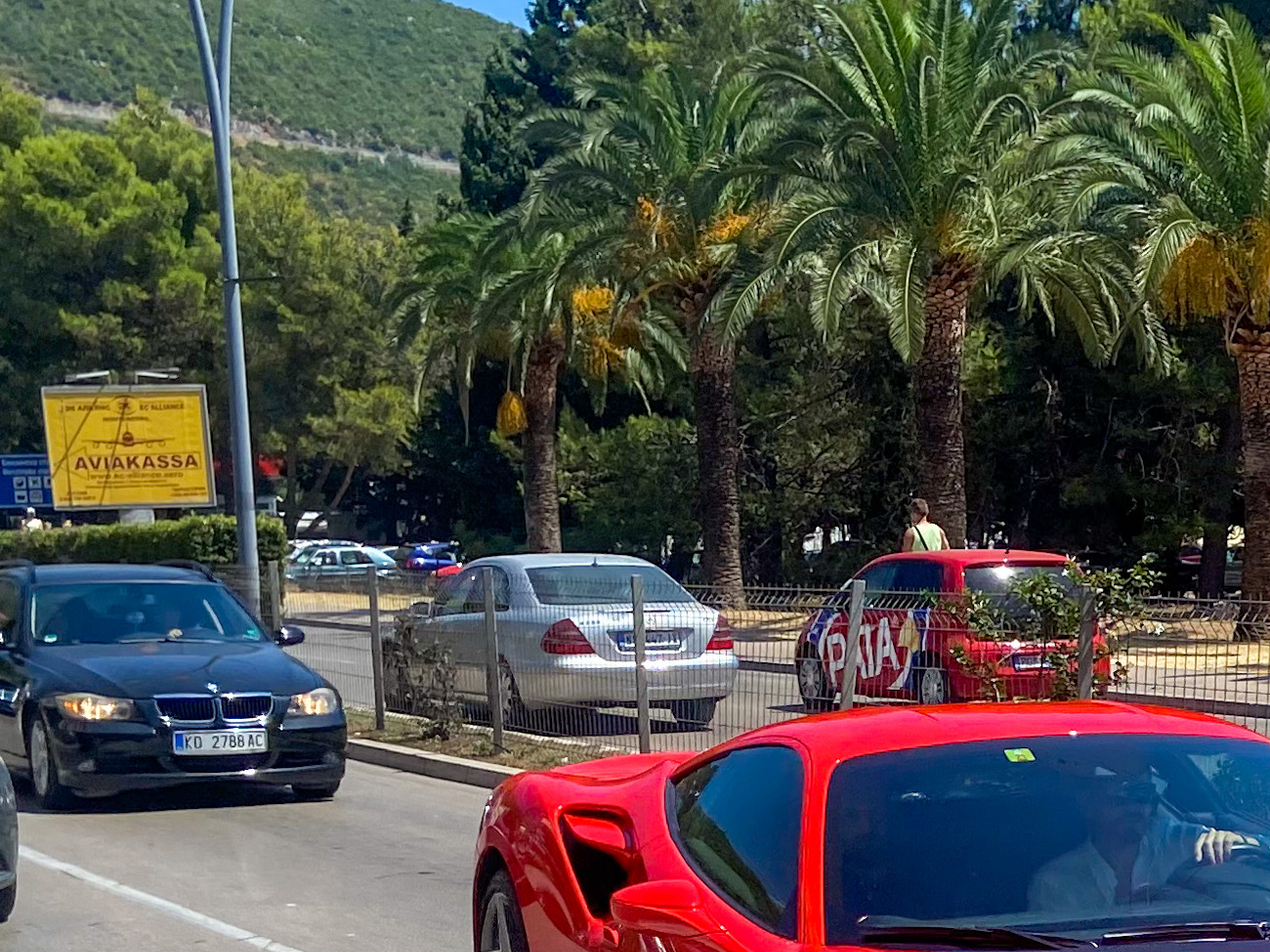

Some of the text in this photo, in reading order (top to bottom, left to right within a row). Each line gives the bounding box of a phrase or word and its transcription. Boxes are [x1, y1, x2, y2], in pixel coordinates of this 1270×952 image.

[75, 454, 198, 470] AVIAKASSA
[212, 734, 244, 749] 2788
[248, 734, 263, 748] AC
